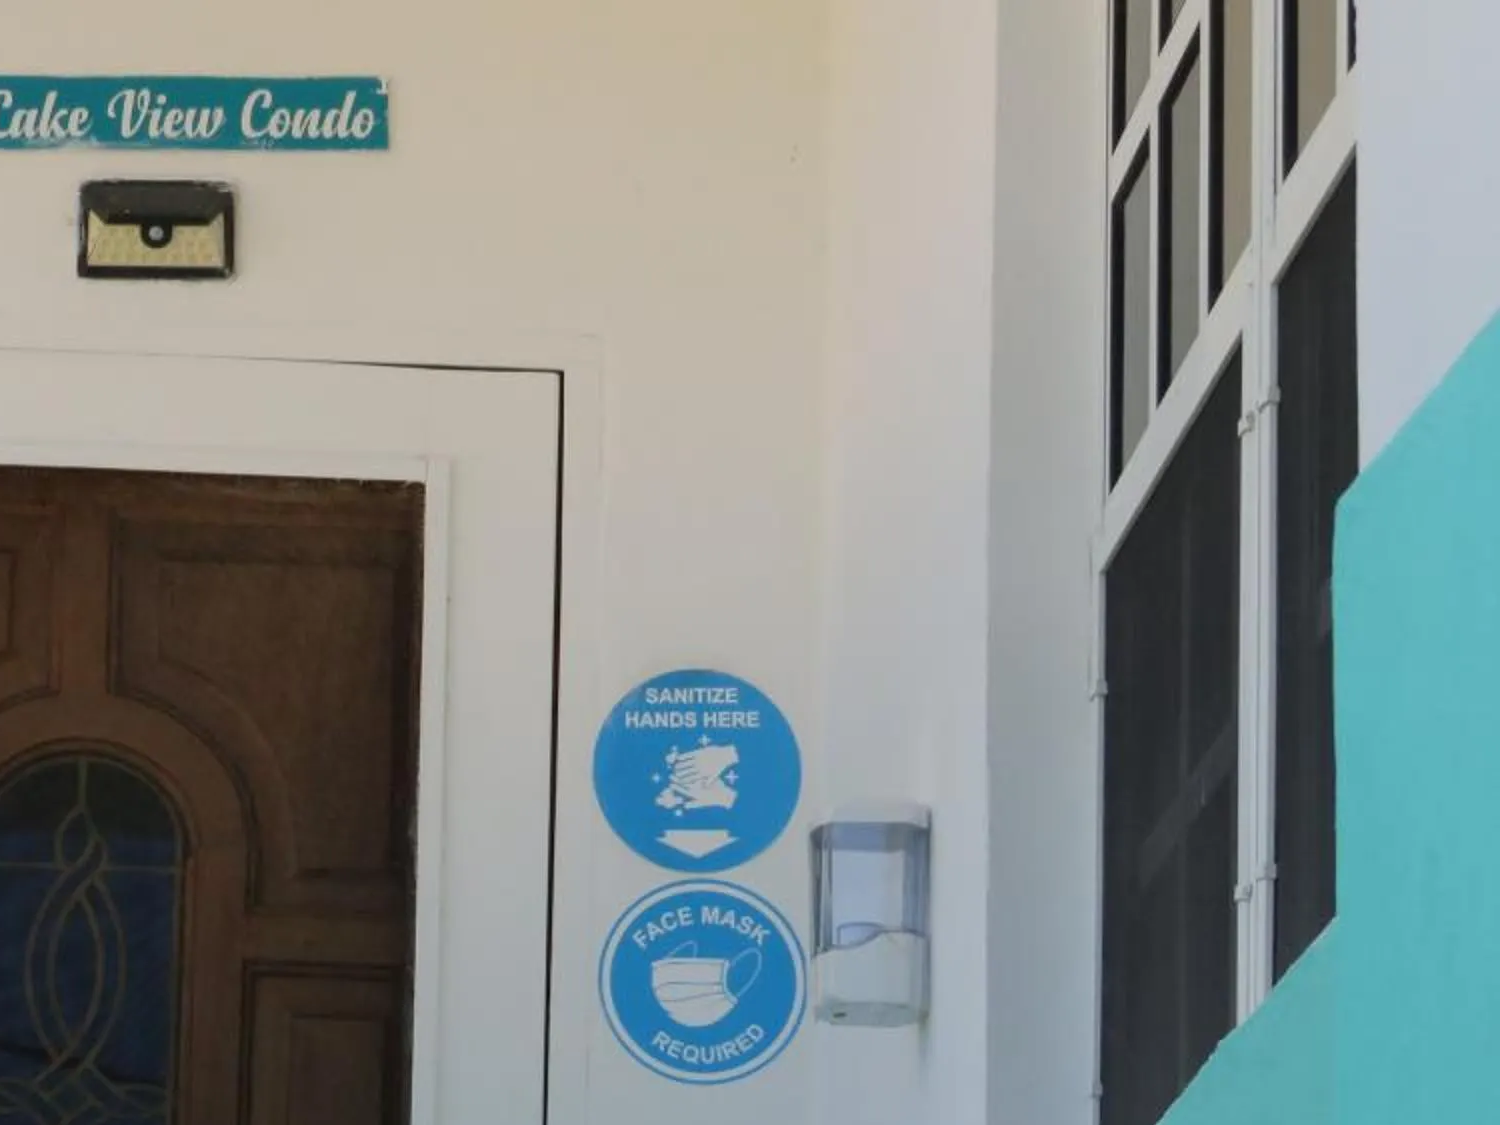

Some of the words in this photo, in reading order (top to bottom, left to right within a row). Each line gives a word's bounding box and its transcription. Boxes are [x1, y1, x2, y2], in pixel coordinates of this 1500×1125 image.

[107, 88, 225, 139] View
[241, 89, 375, 139] Condo
[645, 687, 739, 704] SANITIZE
[625, 711, 697, 729] HANDS
[703, 711, 760, 729] HERE
[632, 906, 695, 950] FACE
[701, 905, 771, 946] MASK
[652, 1024, 765, 1064] REQUIRED
